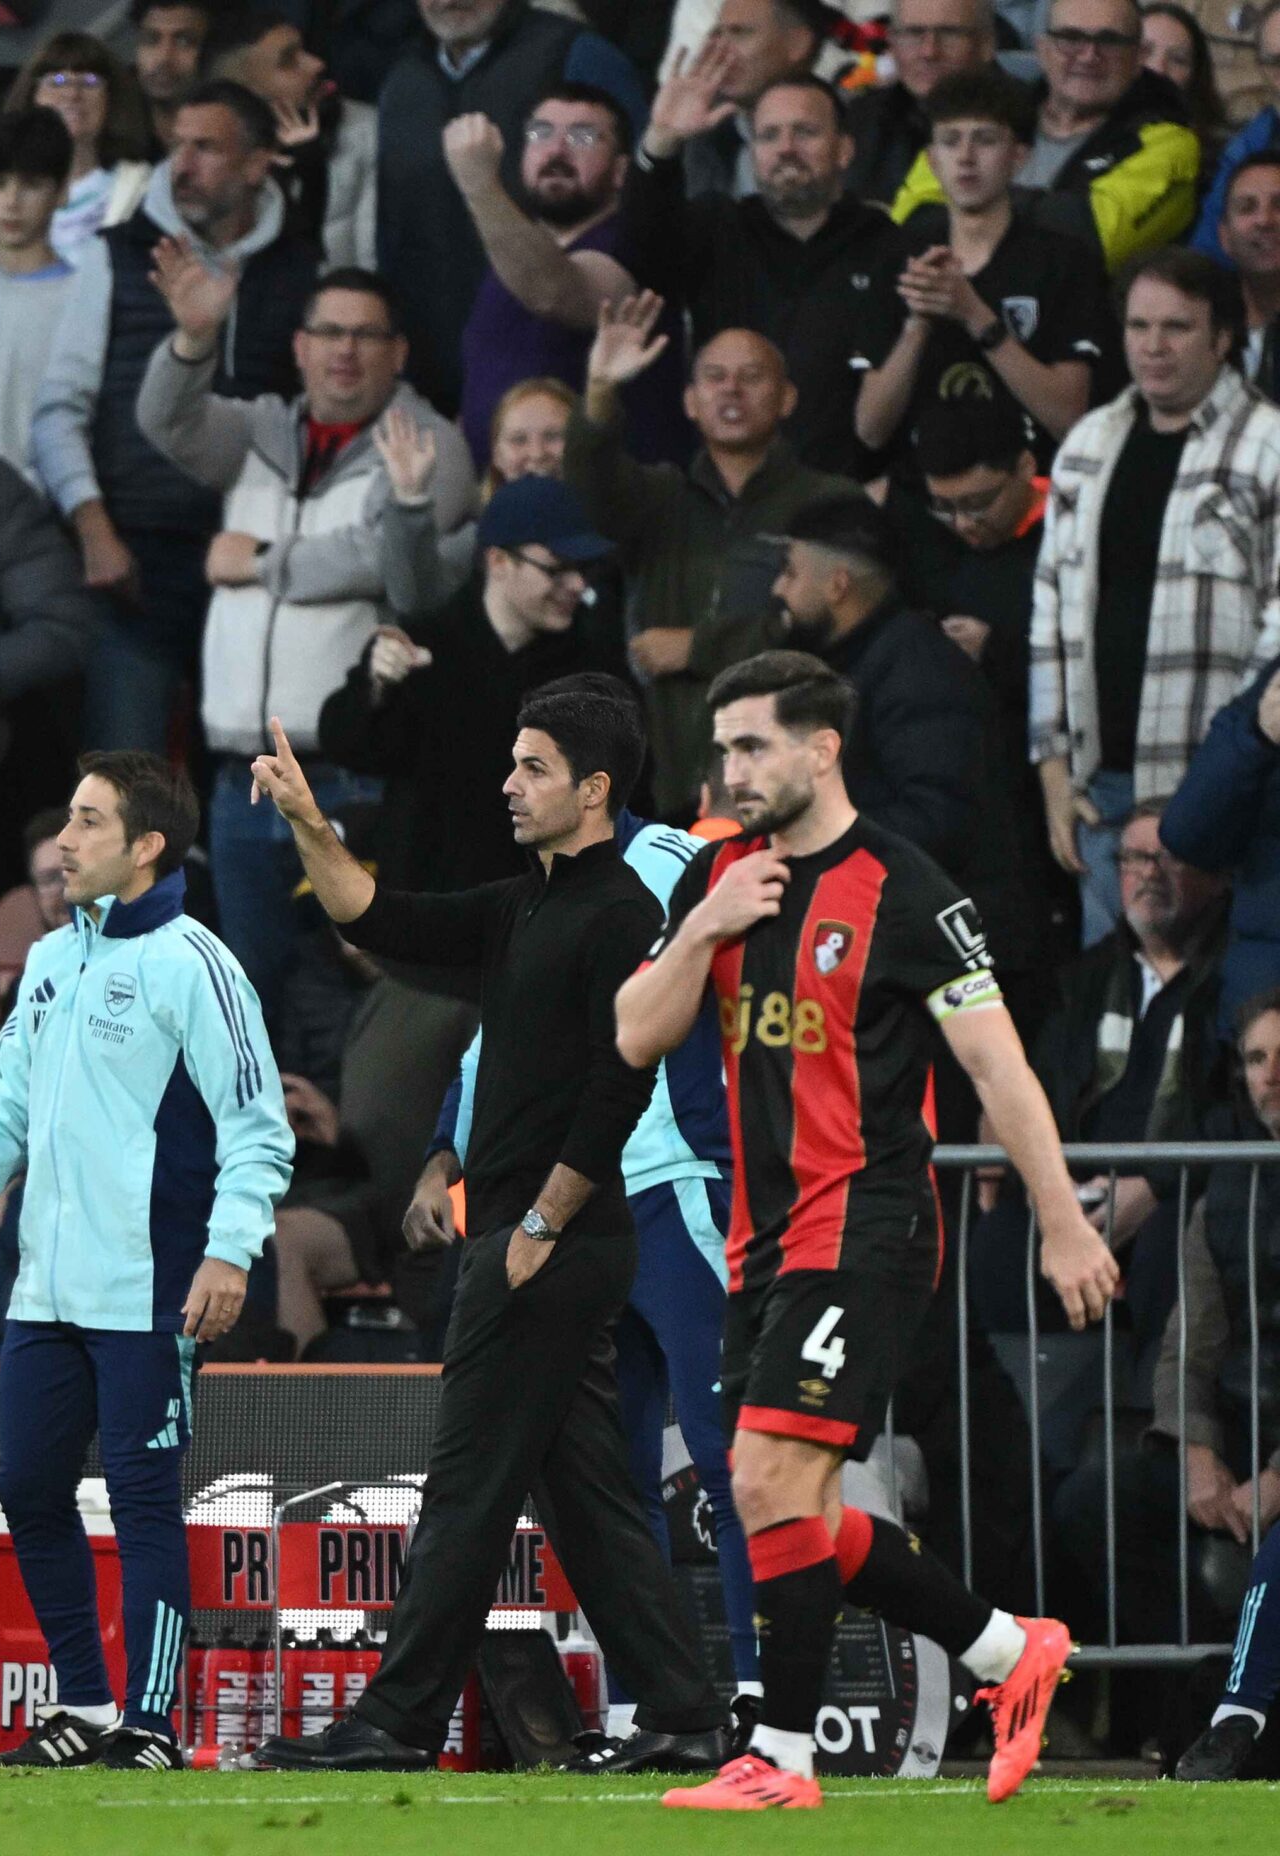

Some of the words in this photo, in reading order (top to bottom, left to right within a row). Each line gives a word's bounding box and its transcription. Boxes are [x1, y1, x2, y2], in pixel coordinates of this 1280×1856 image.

[88, 1014, 135, 1037] Emirates
[801, 1305, 846, 1379] 4
[217, 1670, 248, 1747] PRME
